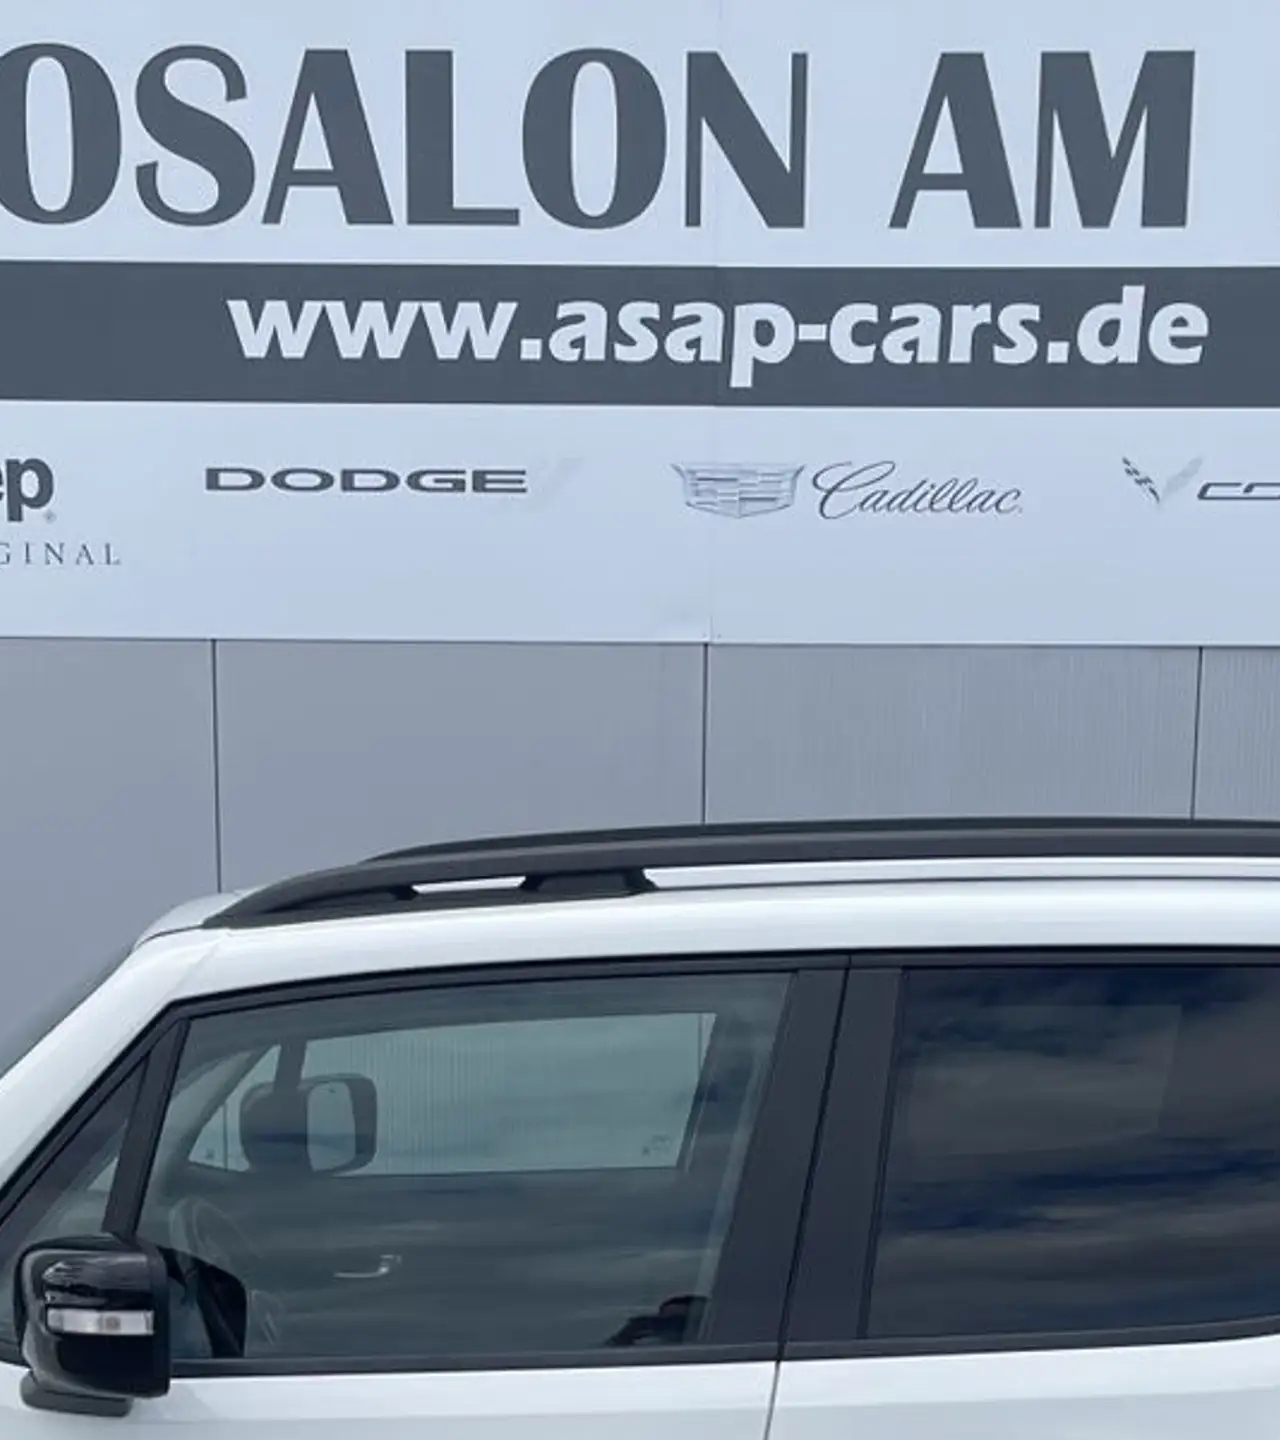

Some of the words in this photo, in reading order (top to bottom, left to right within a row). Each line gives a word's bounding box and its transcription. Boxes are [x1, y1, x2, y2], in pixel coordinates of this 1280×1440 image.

[890, 51, 1196, 229] AM
[227, 285, 1210, 389] www.asap-cars.de
[205, 467, 528, 494] DODGE
[811, 460, 1022, 520] Cadillac
